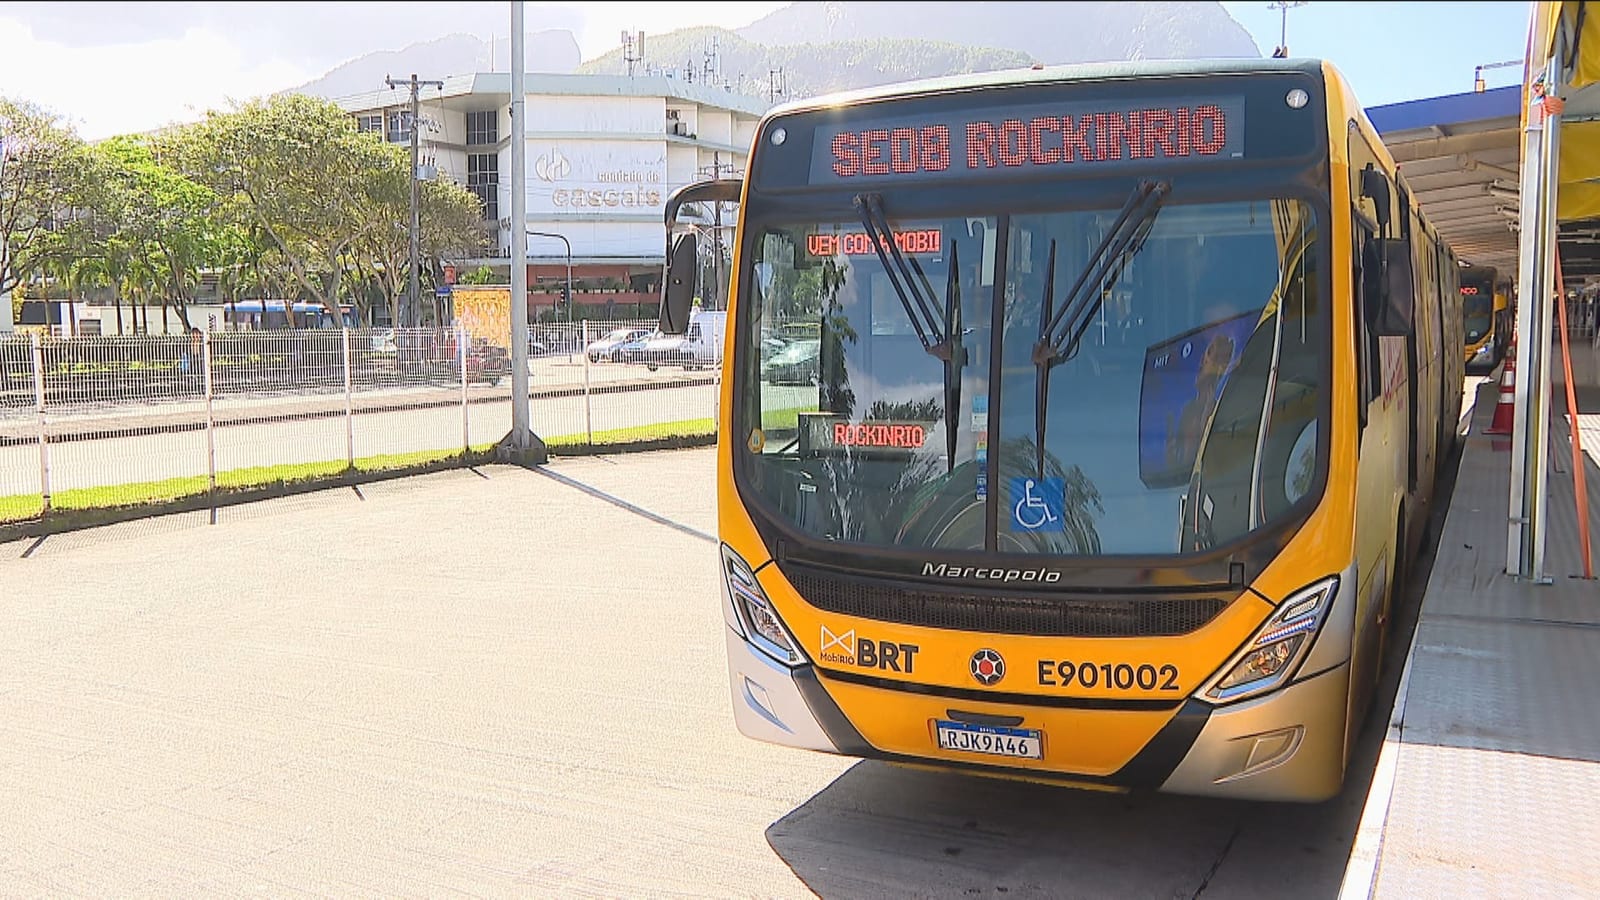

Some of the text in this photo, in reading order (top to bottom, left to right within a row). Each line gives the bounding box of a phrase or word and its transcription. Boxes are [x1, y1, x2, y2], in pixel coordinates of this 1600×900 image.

[965, 104, 1226, 169] ROCKINRIO
[552, 184, 661, 207] cascais
[808, 235, 840, 256] VEM
[843, 233, 876, 254] COM
[834, 423, 924, 447] ROCKINRIO
[921, 561, 1062, 582] Marcopolo
[857, 638, 919, 673] BRT
[1038, 659, 1180, 691] E901002
[947, 730, 1029, 755] RJK9A46
